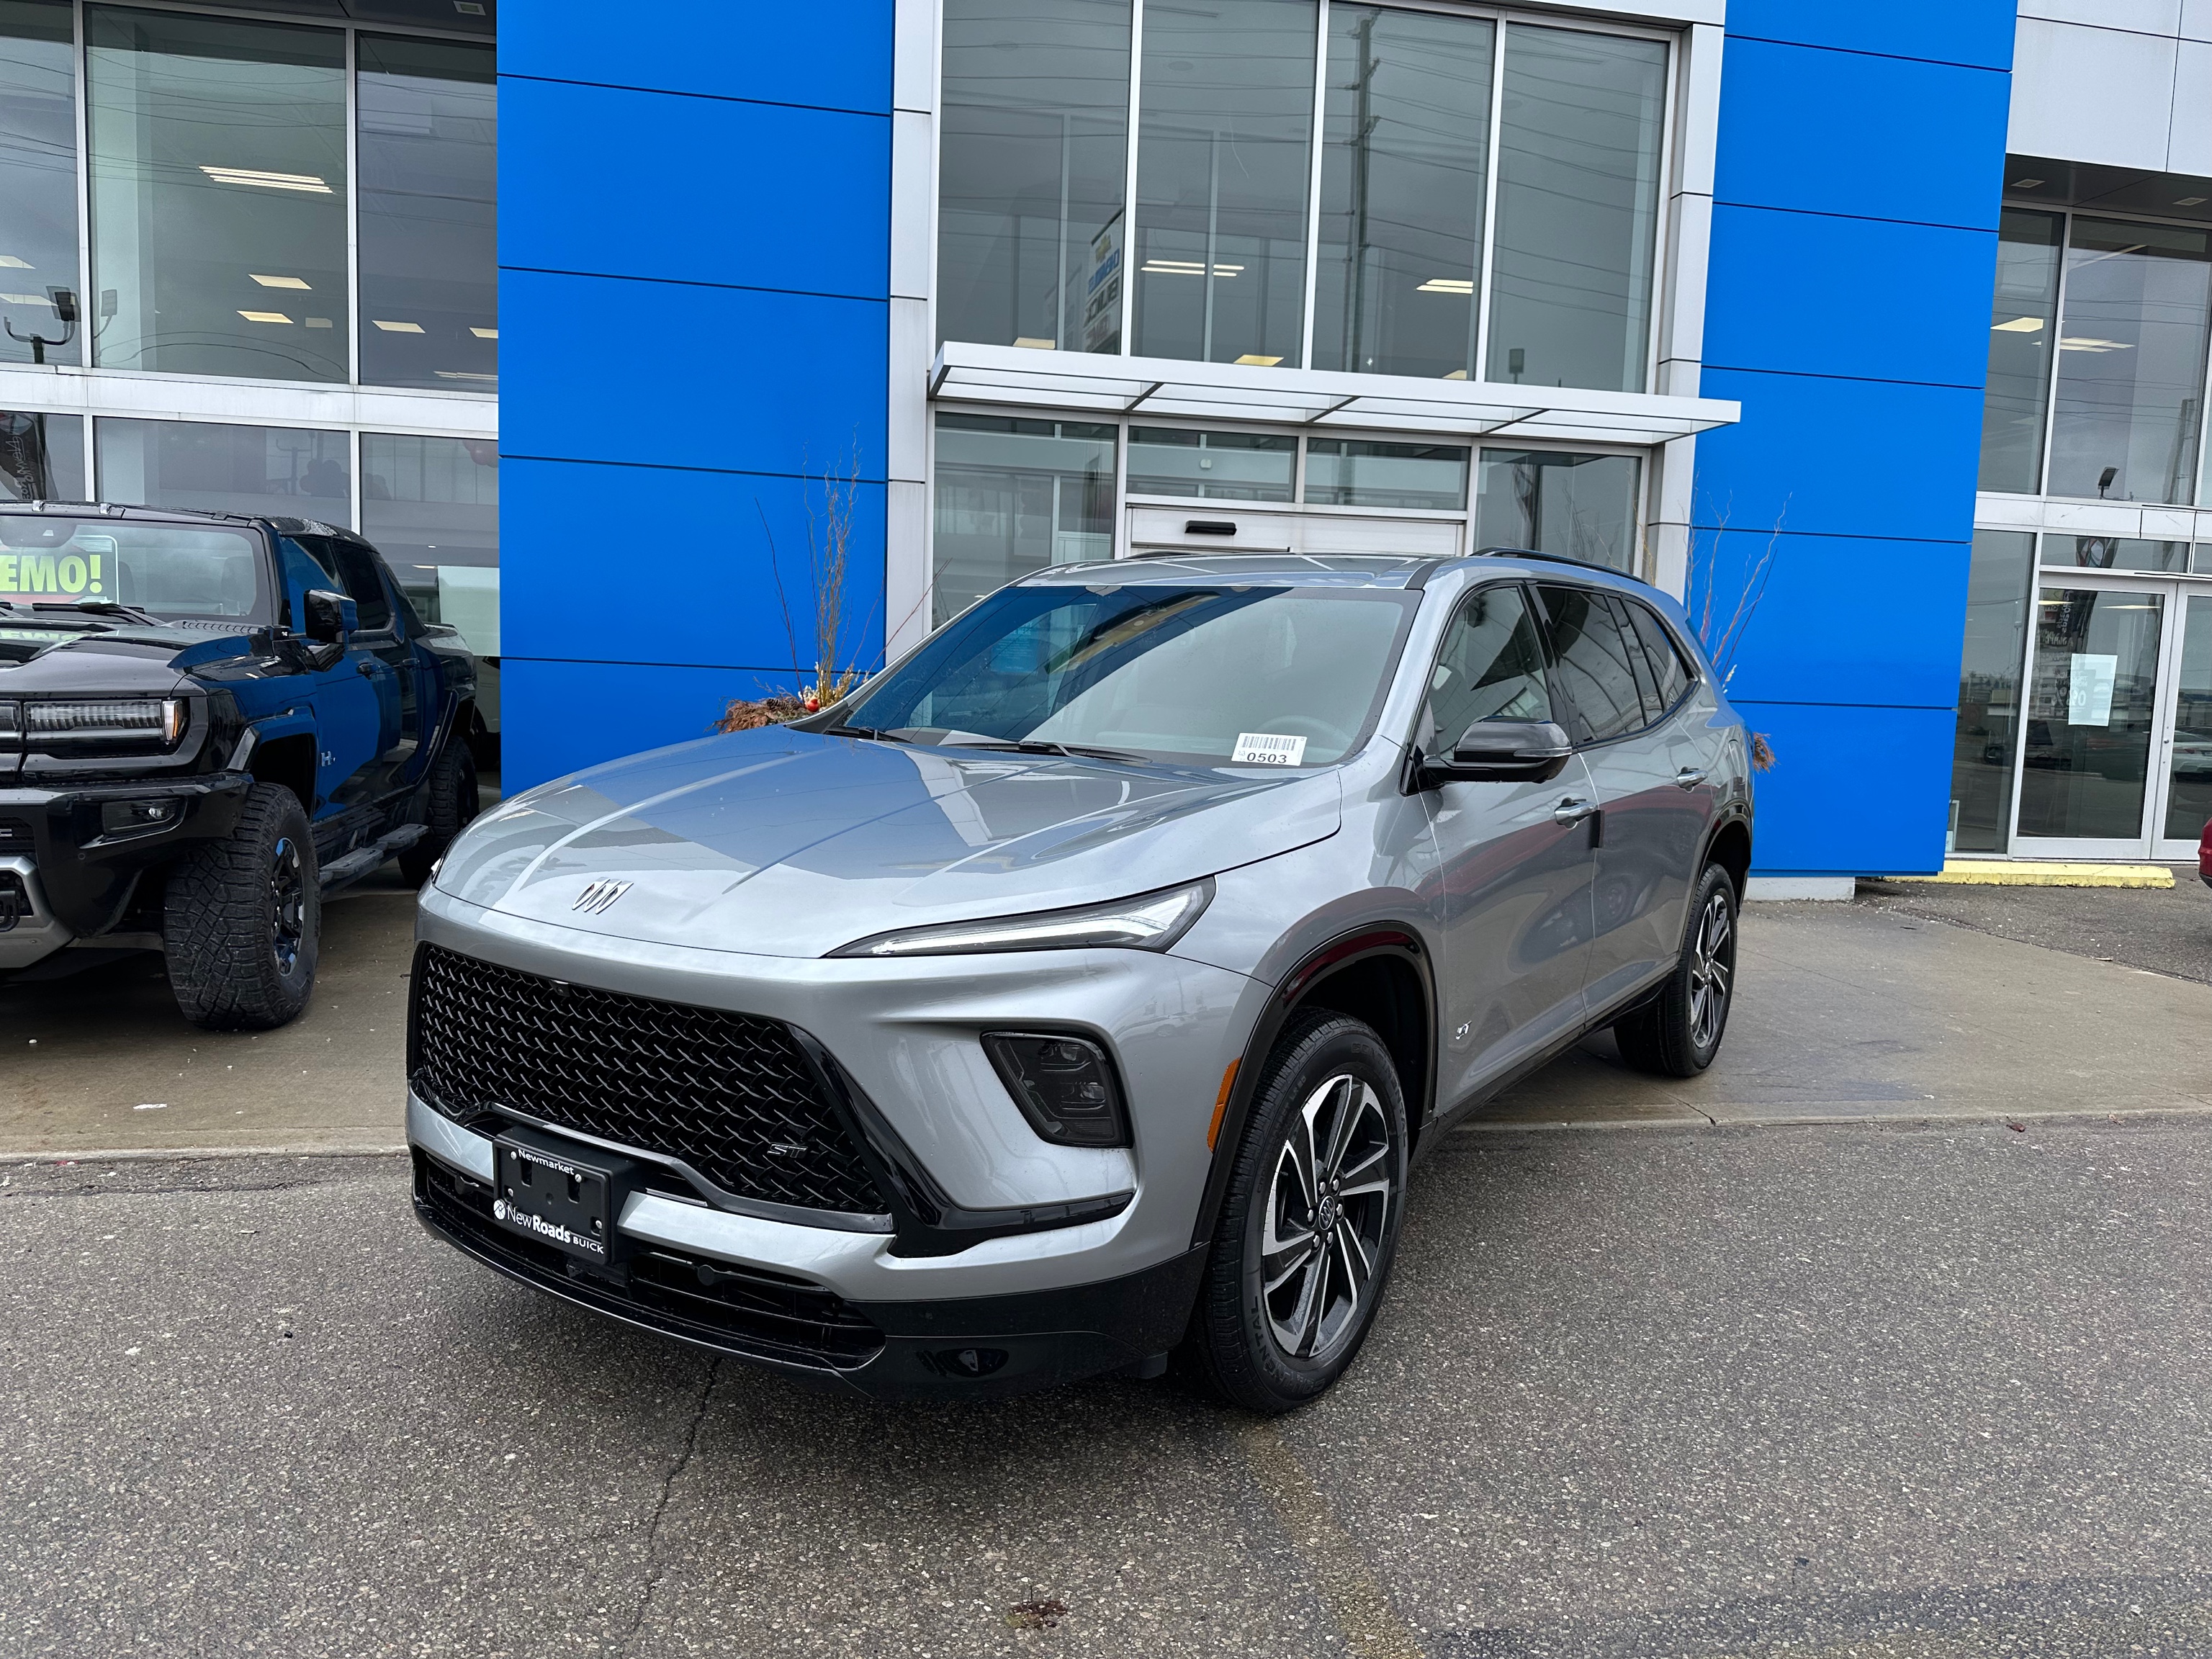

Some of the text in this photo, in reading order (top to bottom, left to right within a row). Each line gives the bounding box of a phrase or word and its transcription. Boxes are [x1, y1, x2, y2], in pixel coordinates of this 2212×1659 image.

[1246, 752, 1287, 764] 0503
[518, 1148, 575, 1176] Newmarket
[767, 1143, 807, 1159] ST
[507, 1205, 604, 1254] NewRoads BUICK
